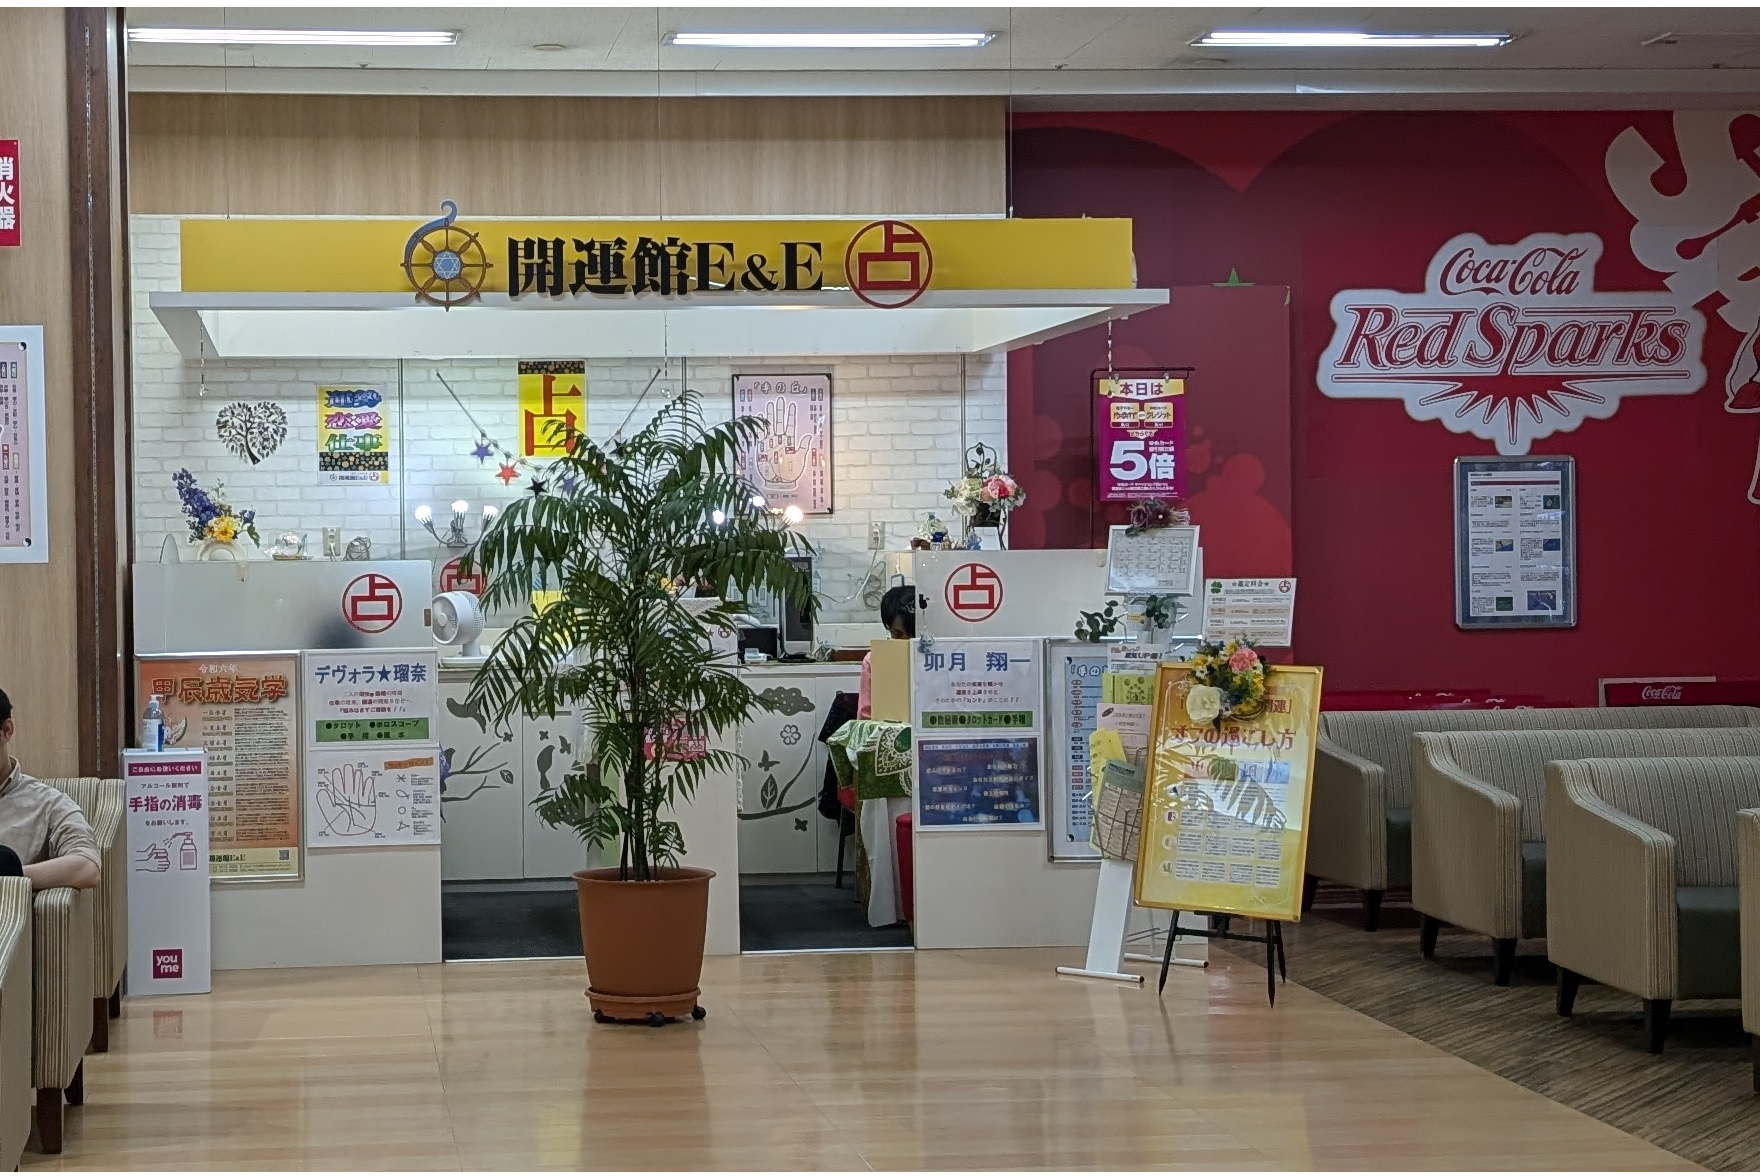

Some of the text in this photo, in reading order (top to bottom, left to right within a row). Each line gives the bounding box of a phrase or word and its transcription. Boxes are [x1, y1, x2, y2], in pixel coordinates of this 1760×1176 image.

[507, 236, 824, 297] 開運館E&E
[855, 221, 926, 293] 占
[1439, 247, 1589, 297] Coca-Cola
[1334, 301, 1690, 375] Red Sparks
[1119, 382, 1164, 396] 本日は
[1146, 411, 1172, 420] クレジット
[325, 433, 383, 452] 仕事
[951, 563, 998, 610] 占
[349, 573, 398, 622] 占
[923, 651, 1031, 672] 卯月 翔一
[315, 662, 427, 685] デヴォラ★瑠奈
[151, 674, 288, 705] 甲辰歳気学
[1641, 685, 1683, 700] Coca-Cola
[376, 720, 420, 728] ホロスコープ
[967, 714, 1003, 725] タロットカード
[1170, 724, 1297, 750] オフの過ごし方
[132, 765, 198, 773] ご自由にお使いください
[128, 794, 203, 813] 手指の消毒
[145, 819, 189, 827] をお願いします。
[156, 954, 178, 967] you
[160, 961, 180, 973] me
